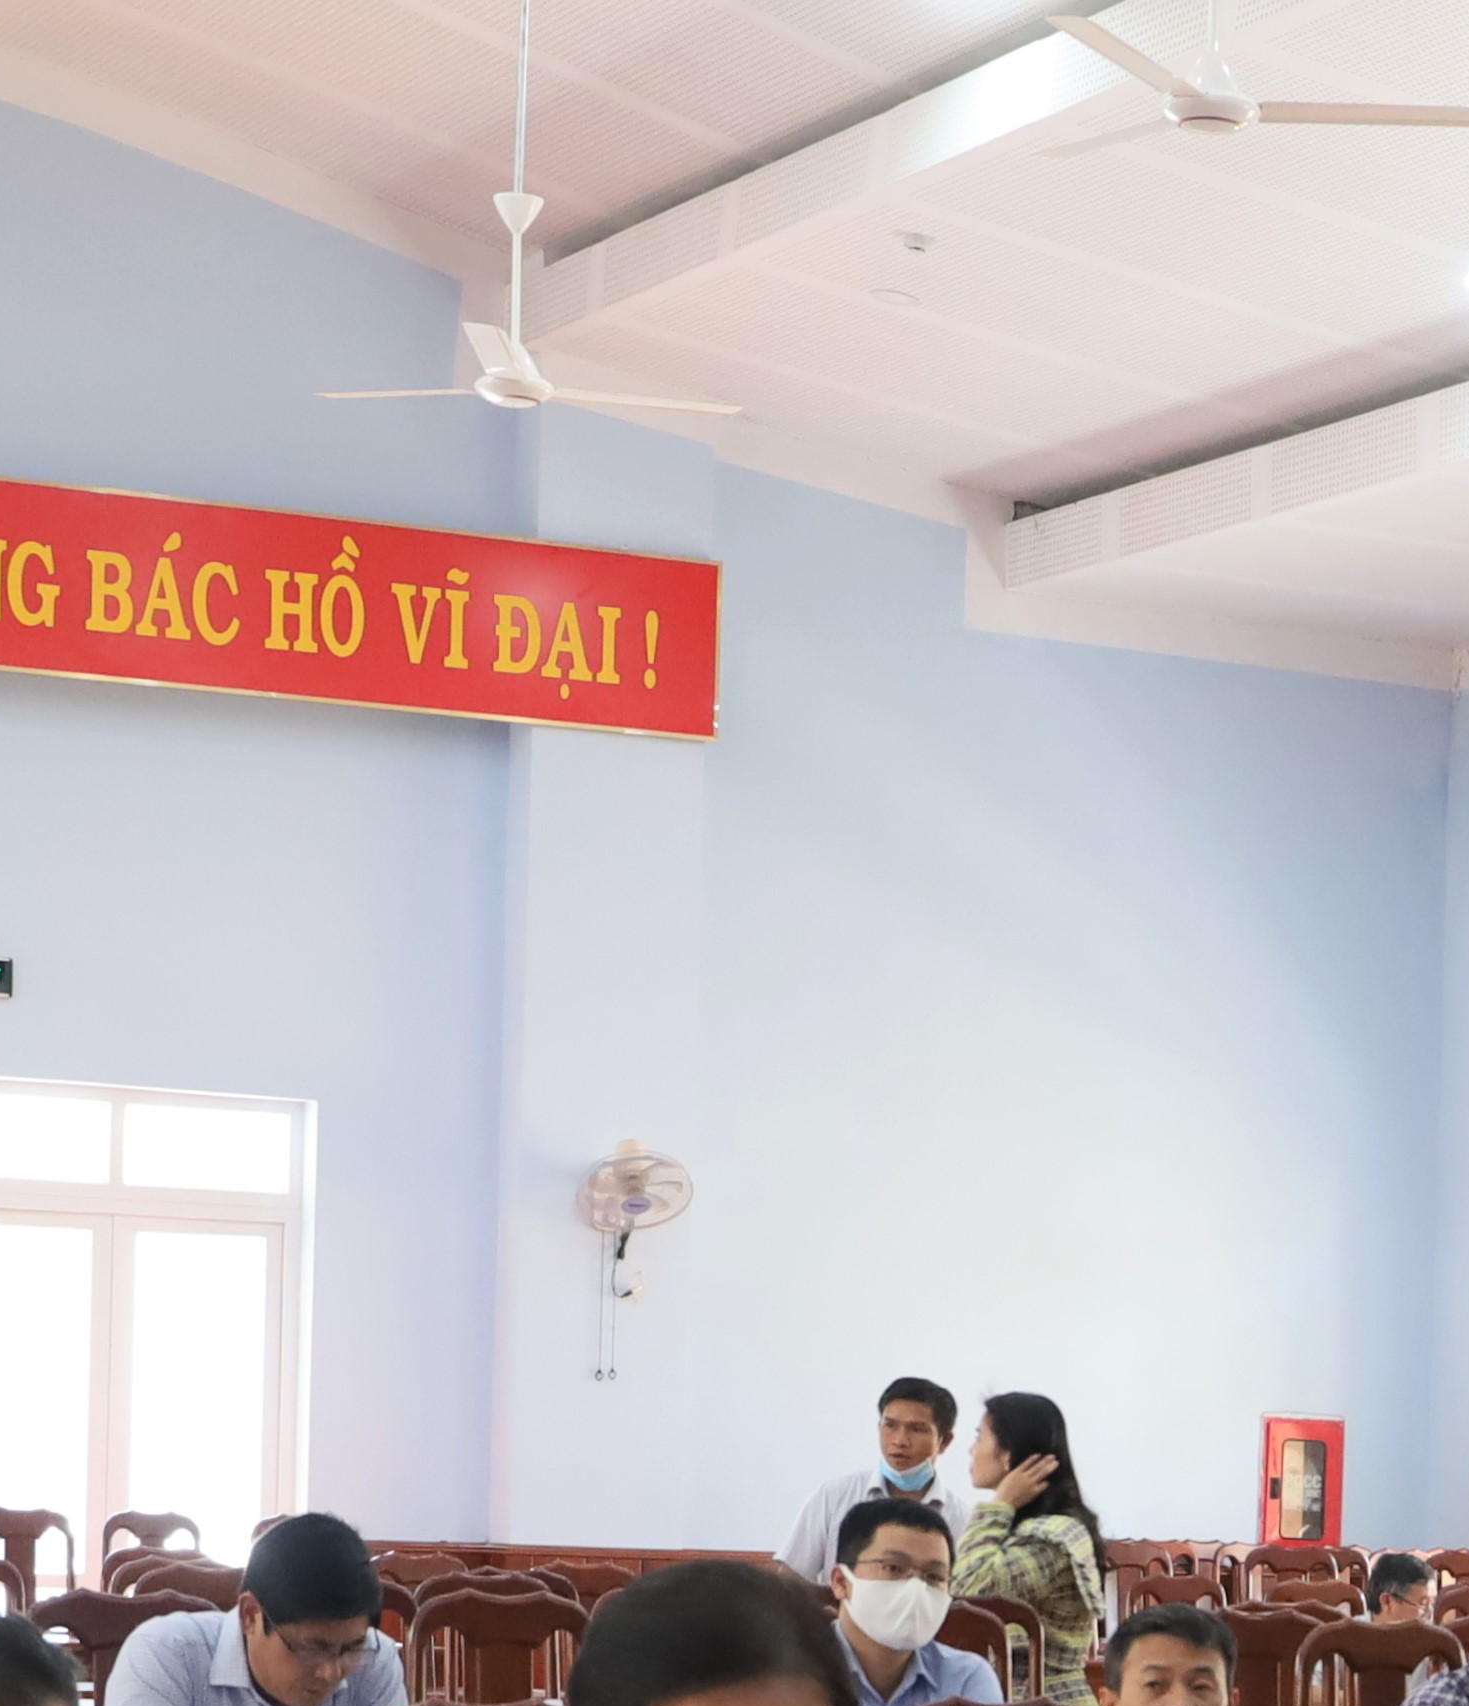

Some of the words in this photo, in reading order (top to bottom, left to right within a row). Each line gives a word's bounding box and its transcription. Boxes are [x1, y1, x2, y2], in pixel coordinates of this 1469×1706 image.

[85, 531, 241, 646] BÁC
[264, 535, 365, 658] HỒ
[390, 567, 470, 670] VĨ
[492, 593, 622, 699] ĐẠI
